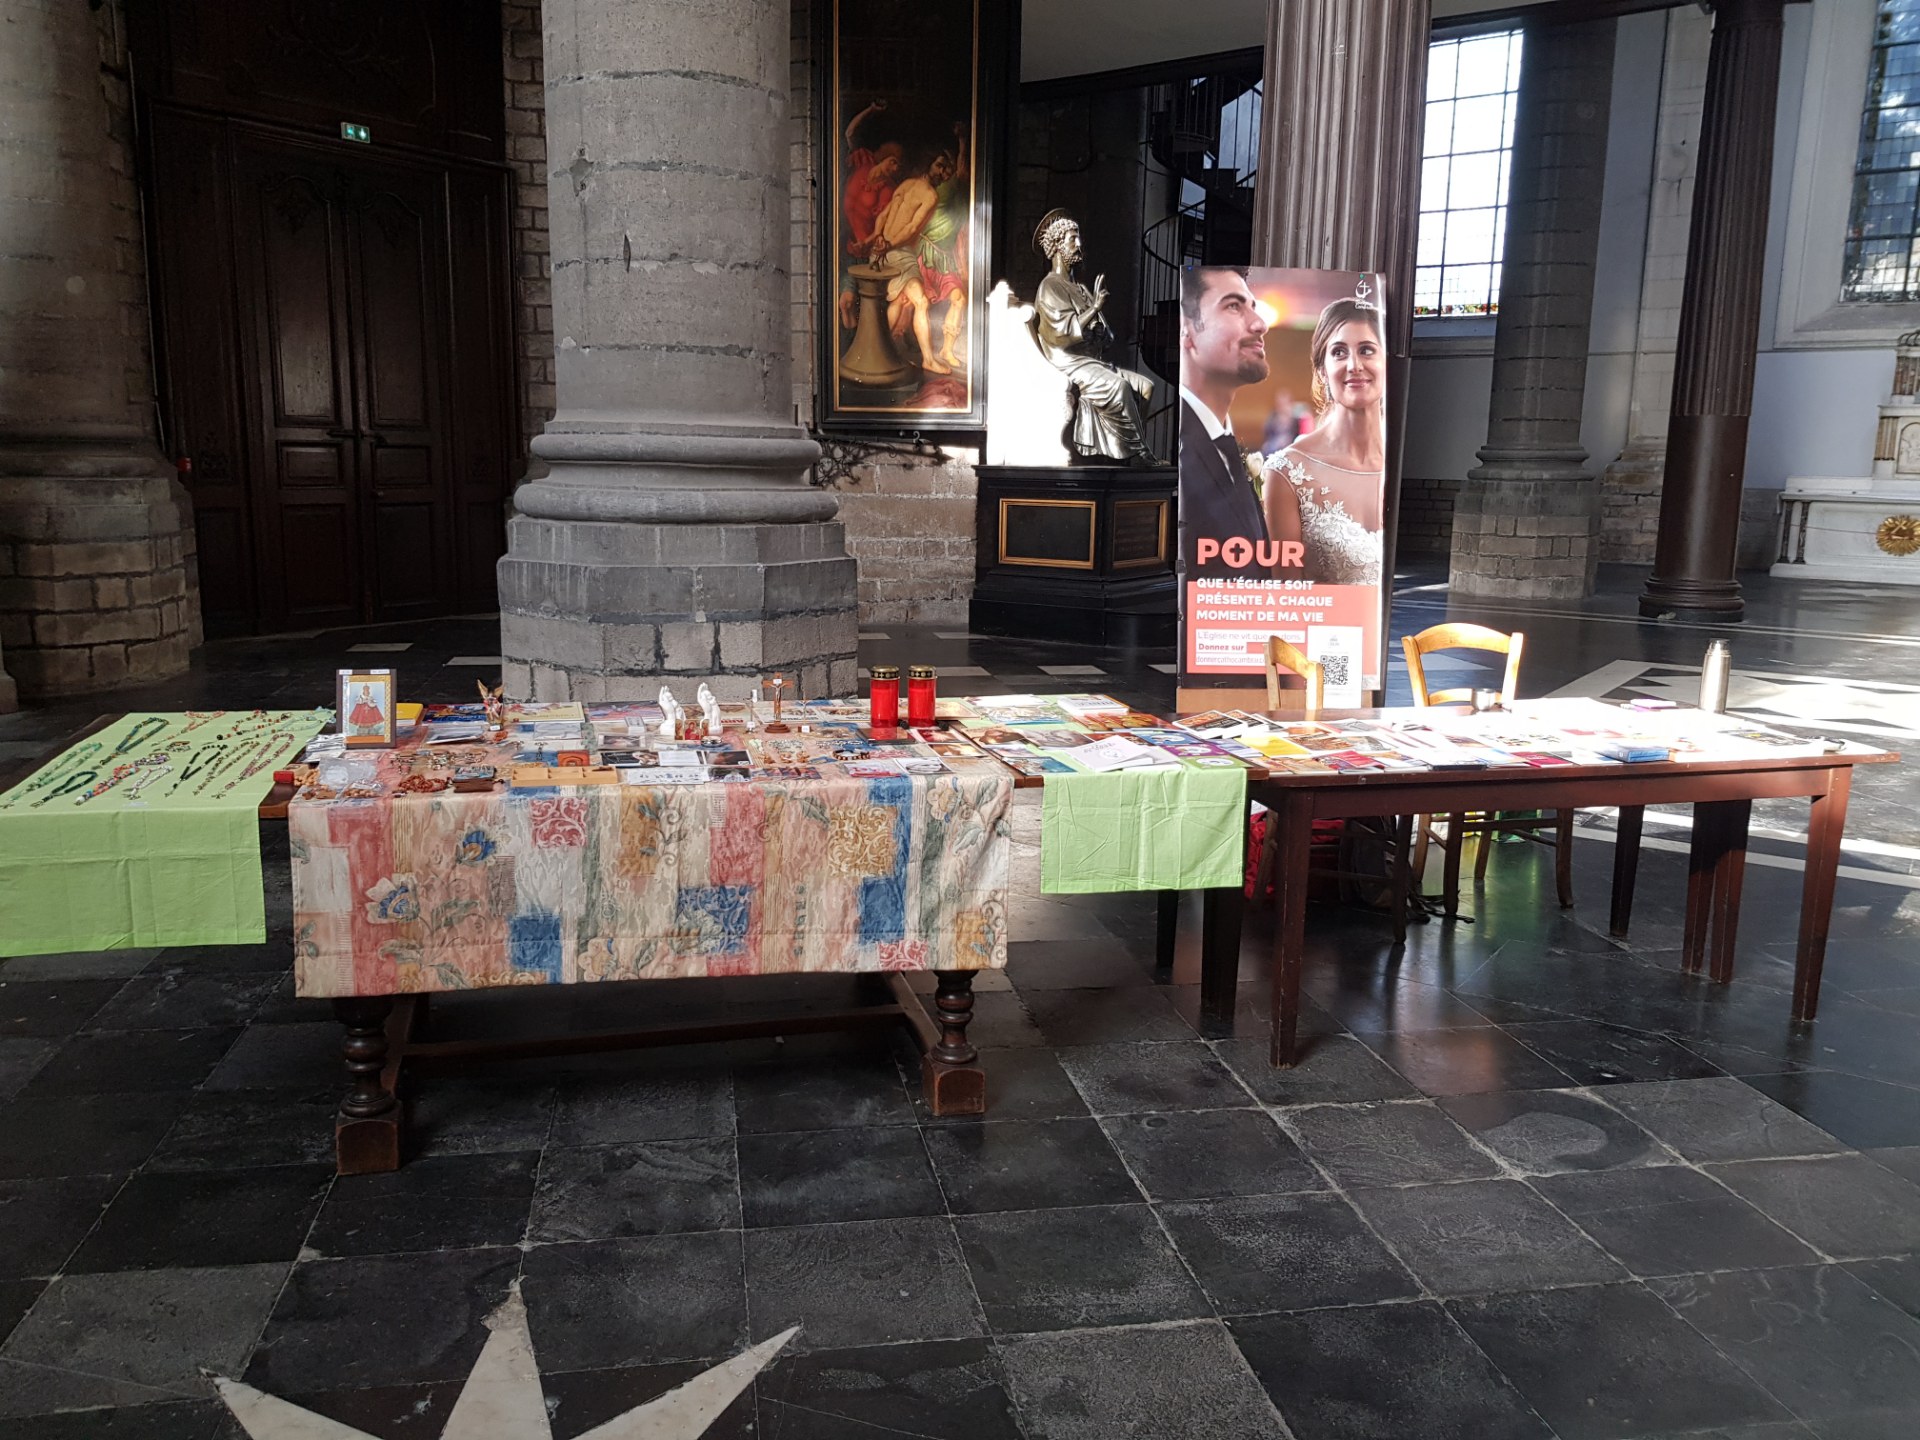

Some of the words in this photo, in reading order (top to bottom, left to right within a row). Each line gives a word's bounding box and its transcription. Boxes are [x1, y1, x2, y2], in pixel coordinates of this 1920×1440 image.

[1197, 536, 1304, 568] POUR
[1197, 578, 1224, 589] QUE
[1284, 580, 1314, 590] SOIT
[1197, 591, 1262, 605] PRÉSENTE
[1266, 593, 1275, 605] À
[1279, 596, 1333, 607] CHAQUE
[1196, 610, 1254, 620] MOMENT
[1257, 611, 1274, 621] DE
[1278, 612, 1298, 621] MA
[1303, 612, 1324, 622] VIE
[1241, 632, 1250, 640] vit
[1198, 643, 1229, 651] Donnez
